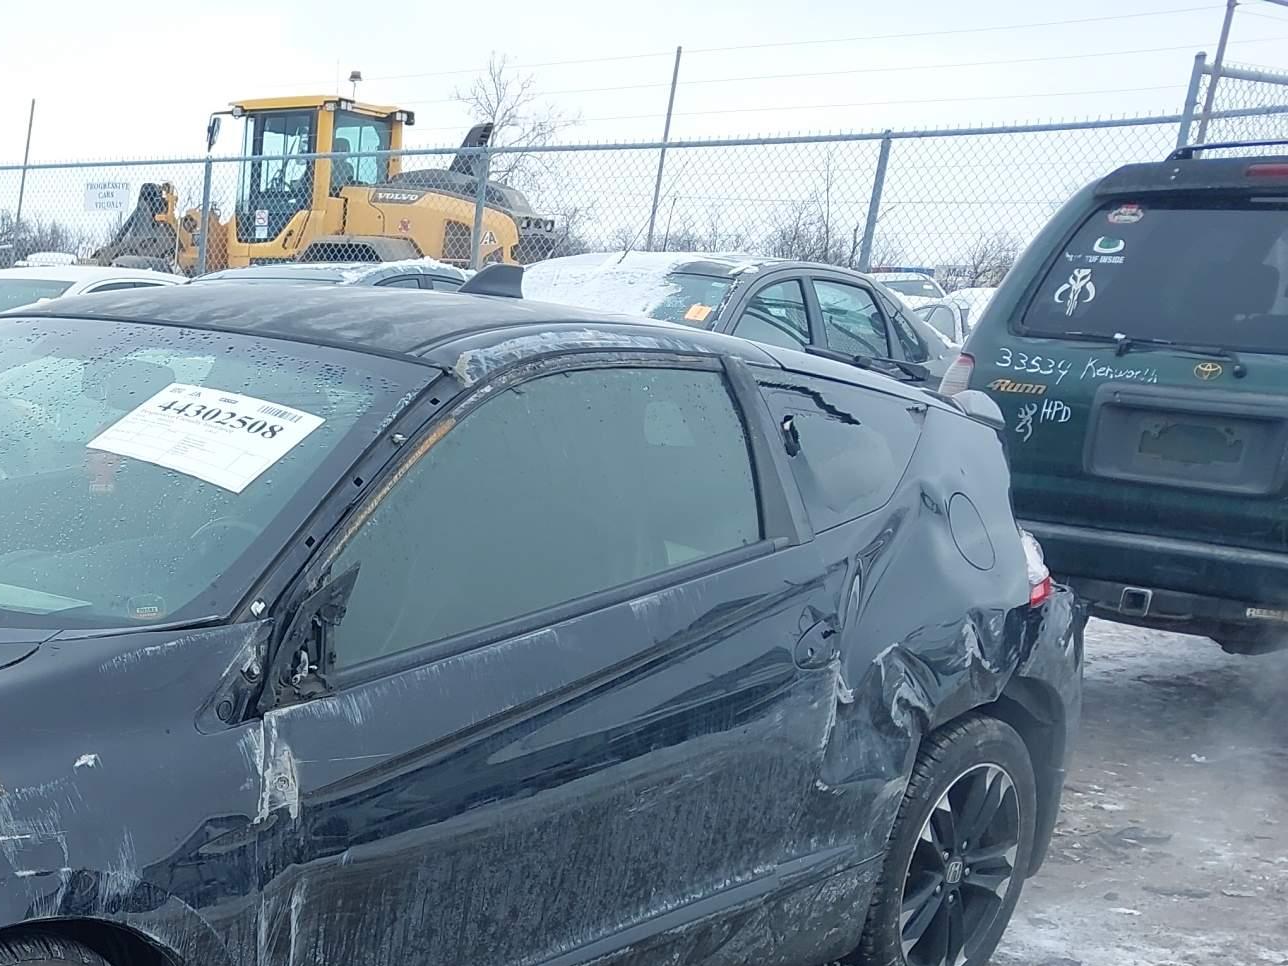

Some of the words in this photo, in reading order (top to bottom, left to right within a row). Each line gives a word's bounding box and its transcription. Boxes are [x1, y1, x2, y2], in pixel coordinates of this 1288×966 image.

[377, 192, 418, 201] VOLVO
[1099, 255, 1126, 264] INSIDE
[995, 347, 1073, 385] 33534
[157, 400, 284, 439] 44302508
[1040, 398, 1072, 423] HPD
